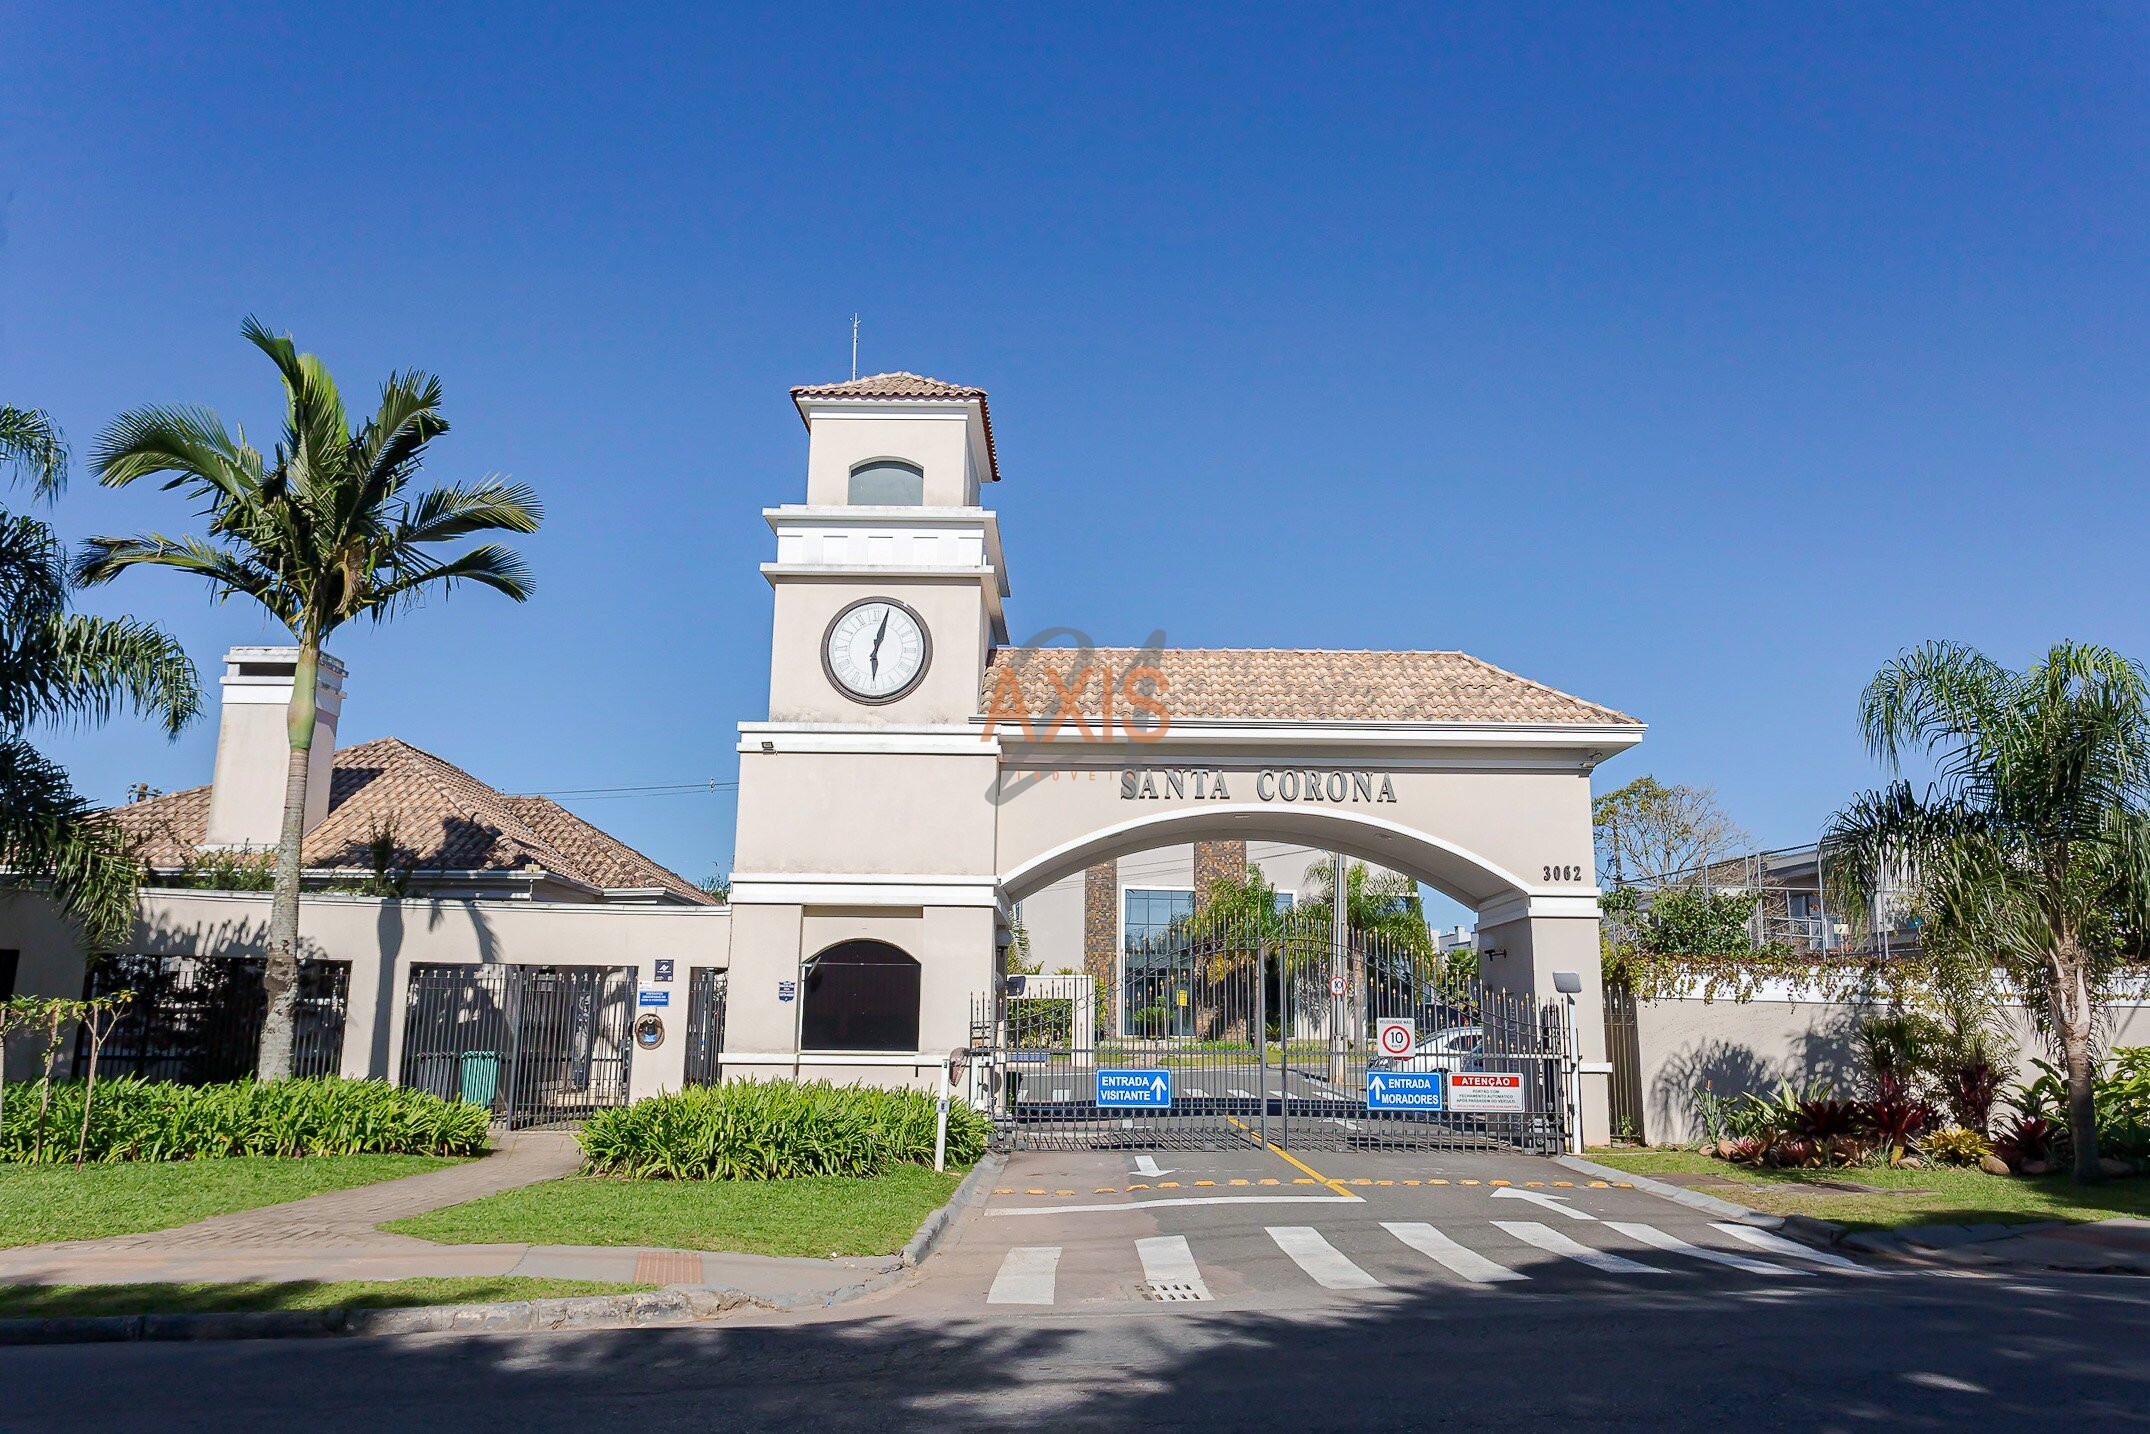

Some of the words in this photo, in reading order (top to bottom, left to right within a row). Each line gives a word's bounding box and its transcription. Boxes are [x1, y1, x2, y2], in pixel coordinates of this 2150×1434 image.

[1120, 768, 1230, 800] SANTA
[1257, 769, 1397, 803] CORONA
[1543, 865, 1581, 881] 3062
[1390, 1031, 1404, 1043] 10
[1101, 1076, 1149, 1087] ENTRADA
[1388, 1078, 1431, 1089] ENTRADA
[1461, 1076, 1510, 1087] ATENÇÃO
[1100, 1090, 1151, 1100] VISITANTE
[1381, 1093, 1439, 1105] MORADORES
